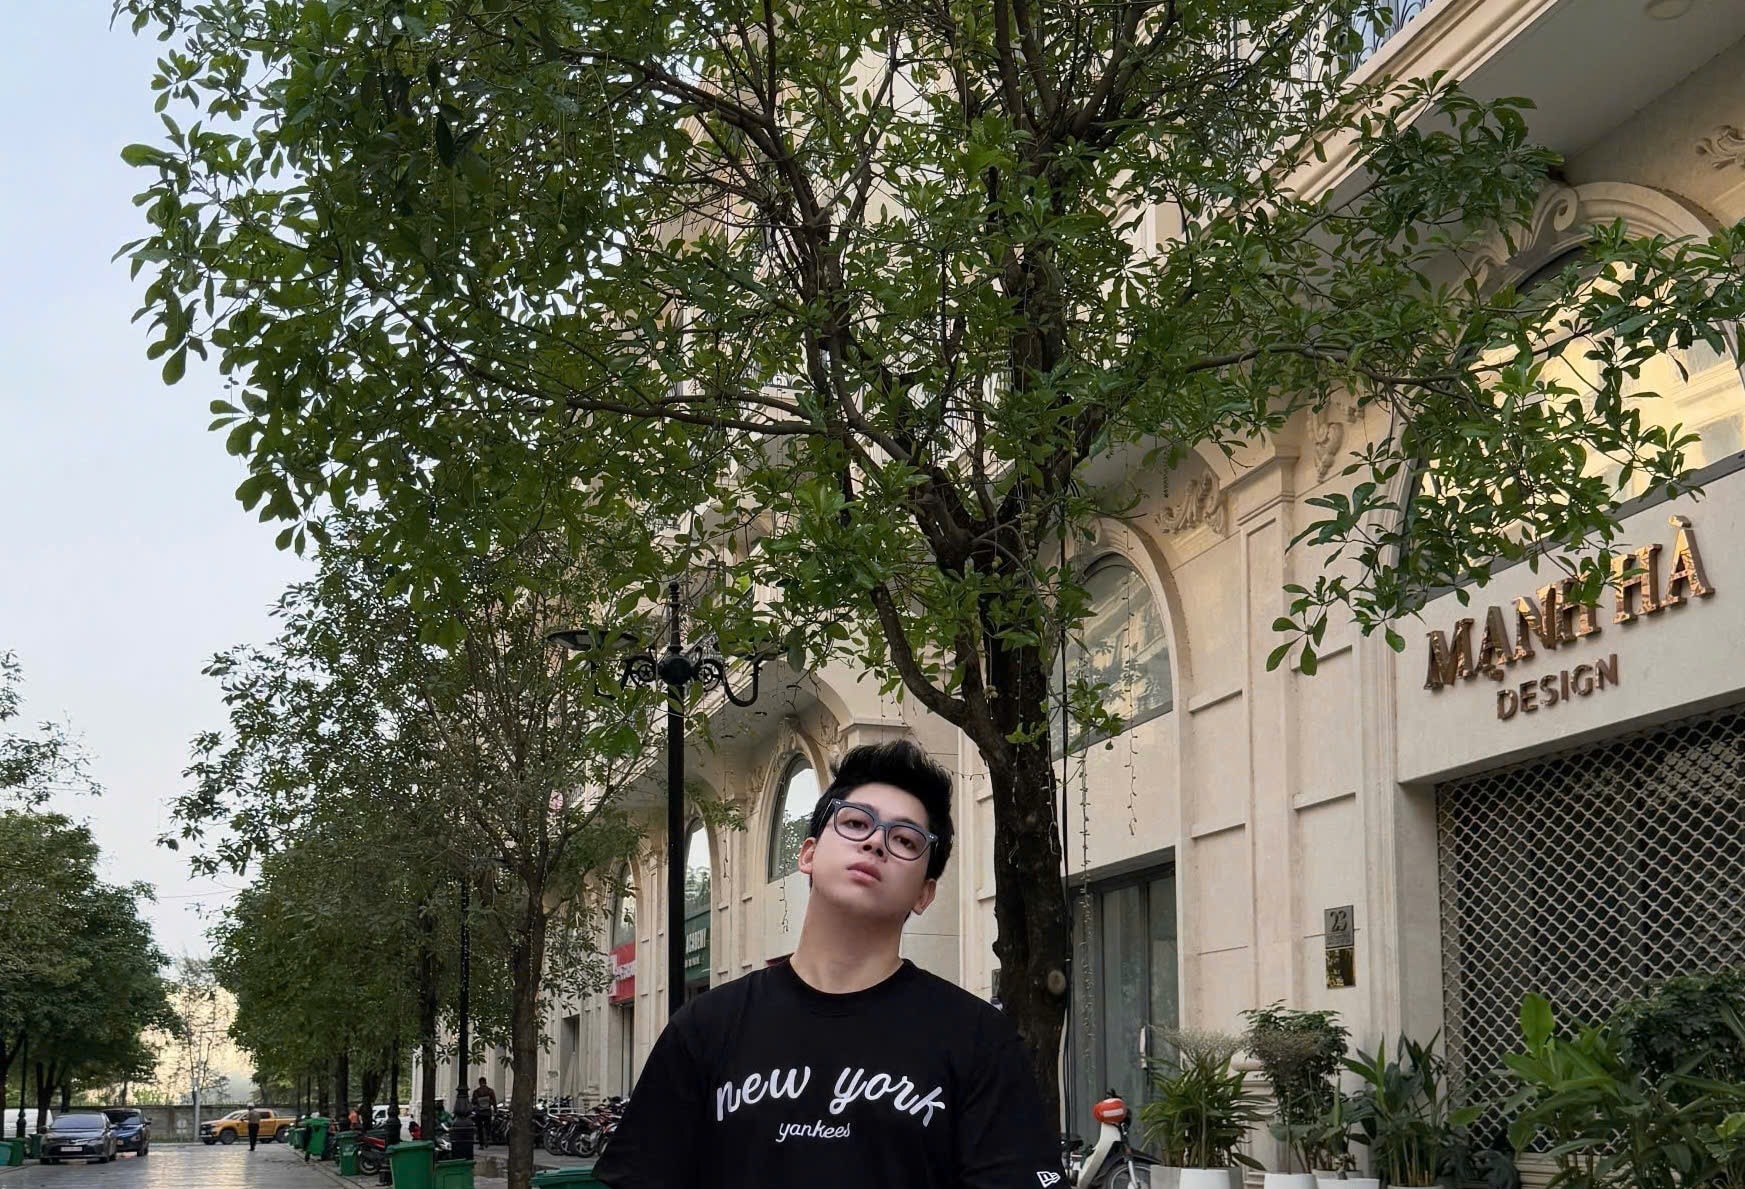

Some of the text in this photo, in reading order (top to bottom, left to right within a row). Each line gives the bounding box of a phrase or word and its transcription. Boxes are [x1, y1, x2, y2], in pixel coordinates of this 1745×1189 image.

[1496, 653, 1620, 720] DESIGN
[1330, 910, 1348, 932] 23
[716, 1065, 946, 1127] new york
[775, 1119, 851, 1143] yankees
